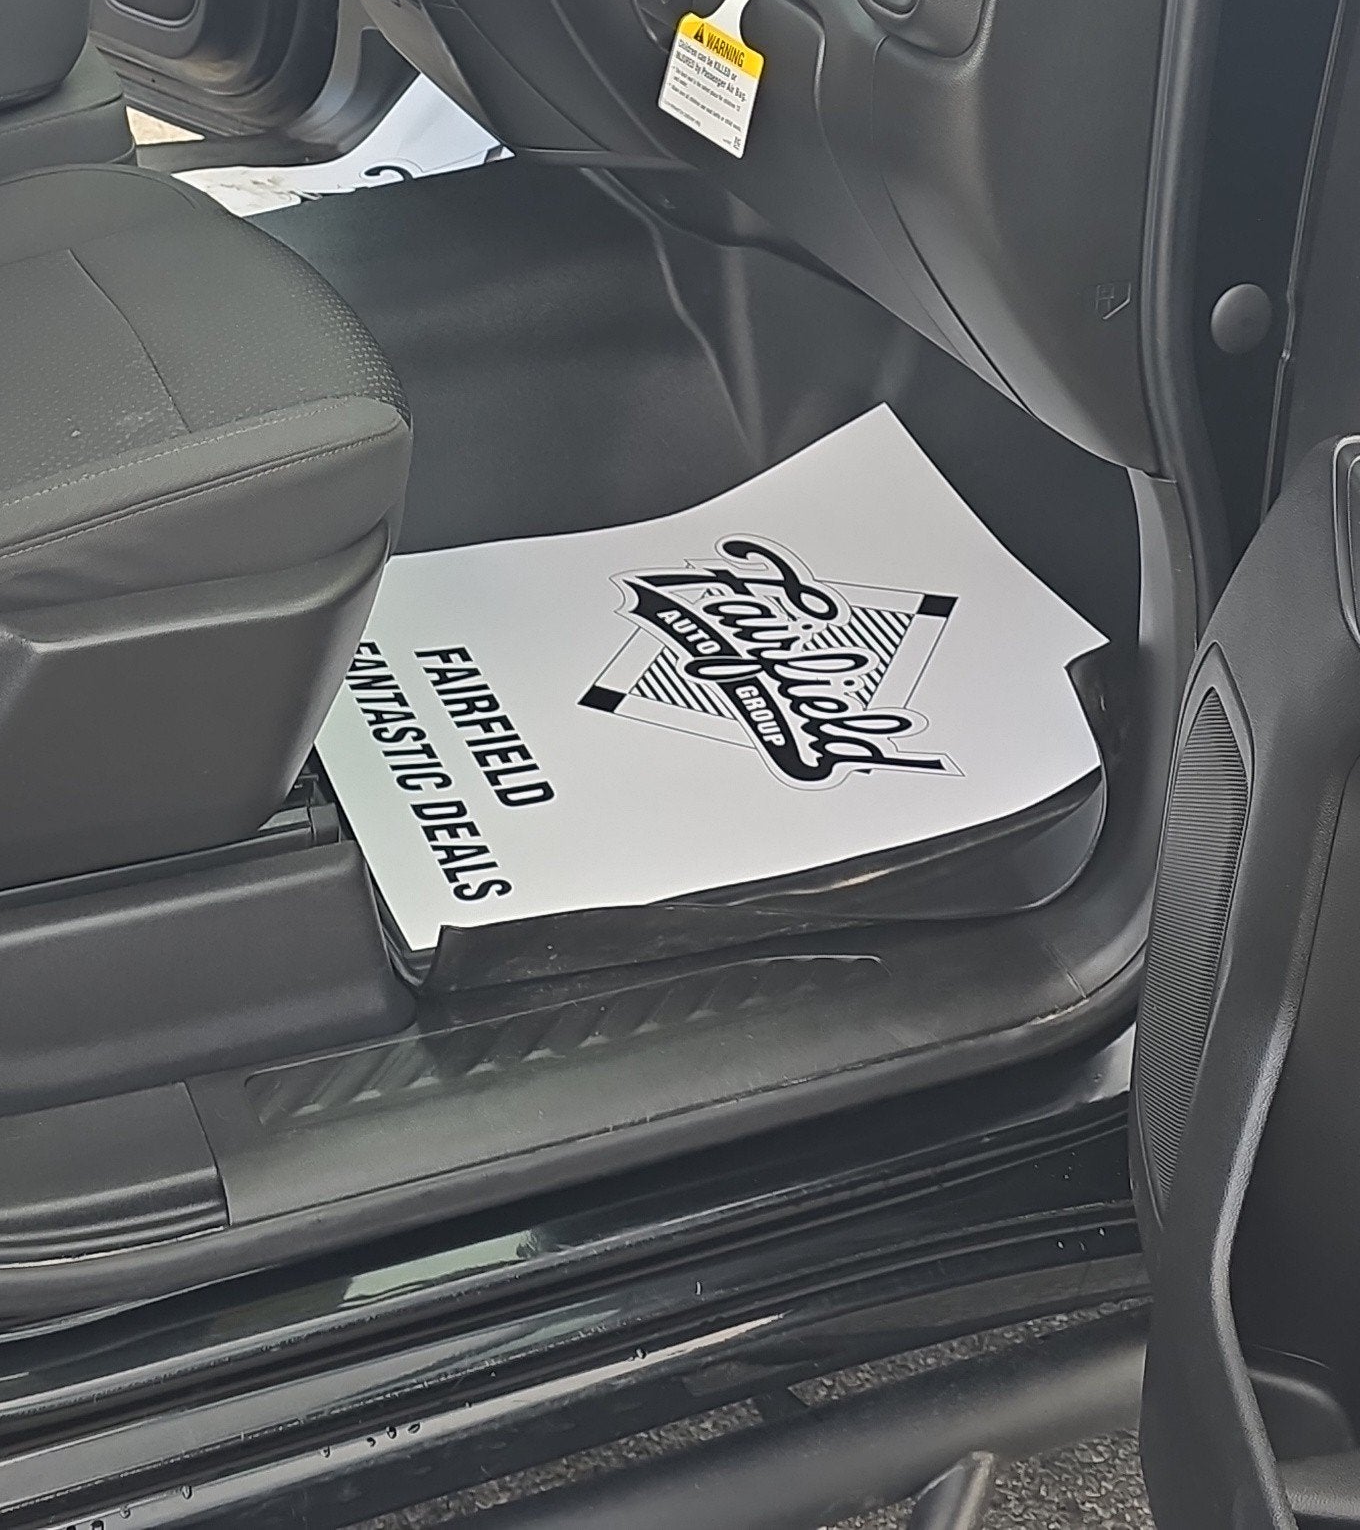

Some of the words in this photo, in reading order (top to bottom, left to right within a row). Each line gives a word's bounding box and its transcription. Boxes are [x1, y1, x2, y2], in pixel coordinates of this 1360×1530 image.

[700, 66, 727, 90] Passenger
[726, 82, 734, 93] Air
[705, 32, 745, 67] WARNING
[713, 60, 731, 77] KILLED
[413, 645, 555, 808] FAIRFIELD
[634, 539, 947, 774] Fairfield
[657, 608, 721, 655] AUTO
[735, 684, 786, 748] GROUP
[344, 641, 454, 792] FANTASTIC
[410, 800, 513, 902] DEALS
